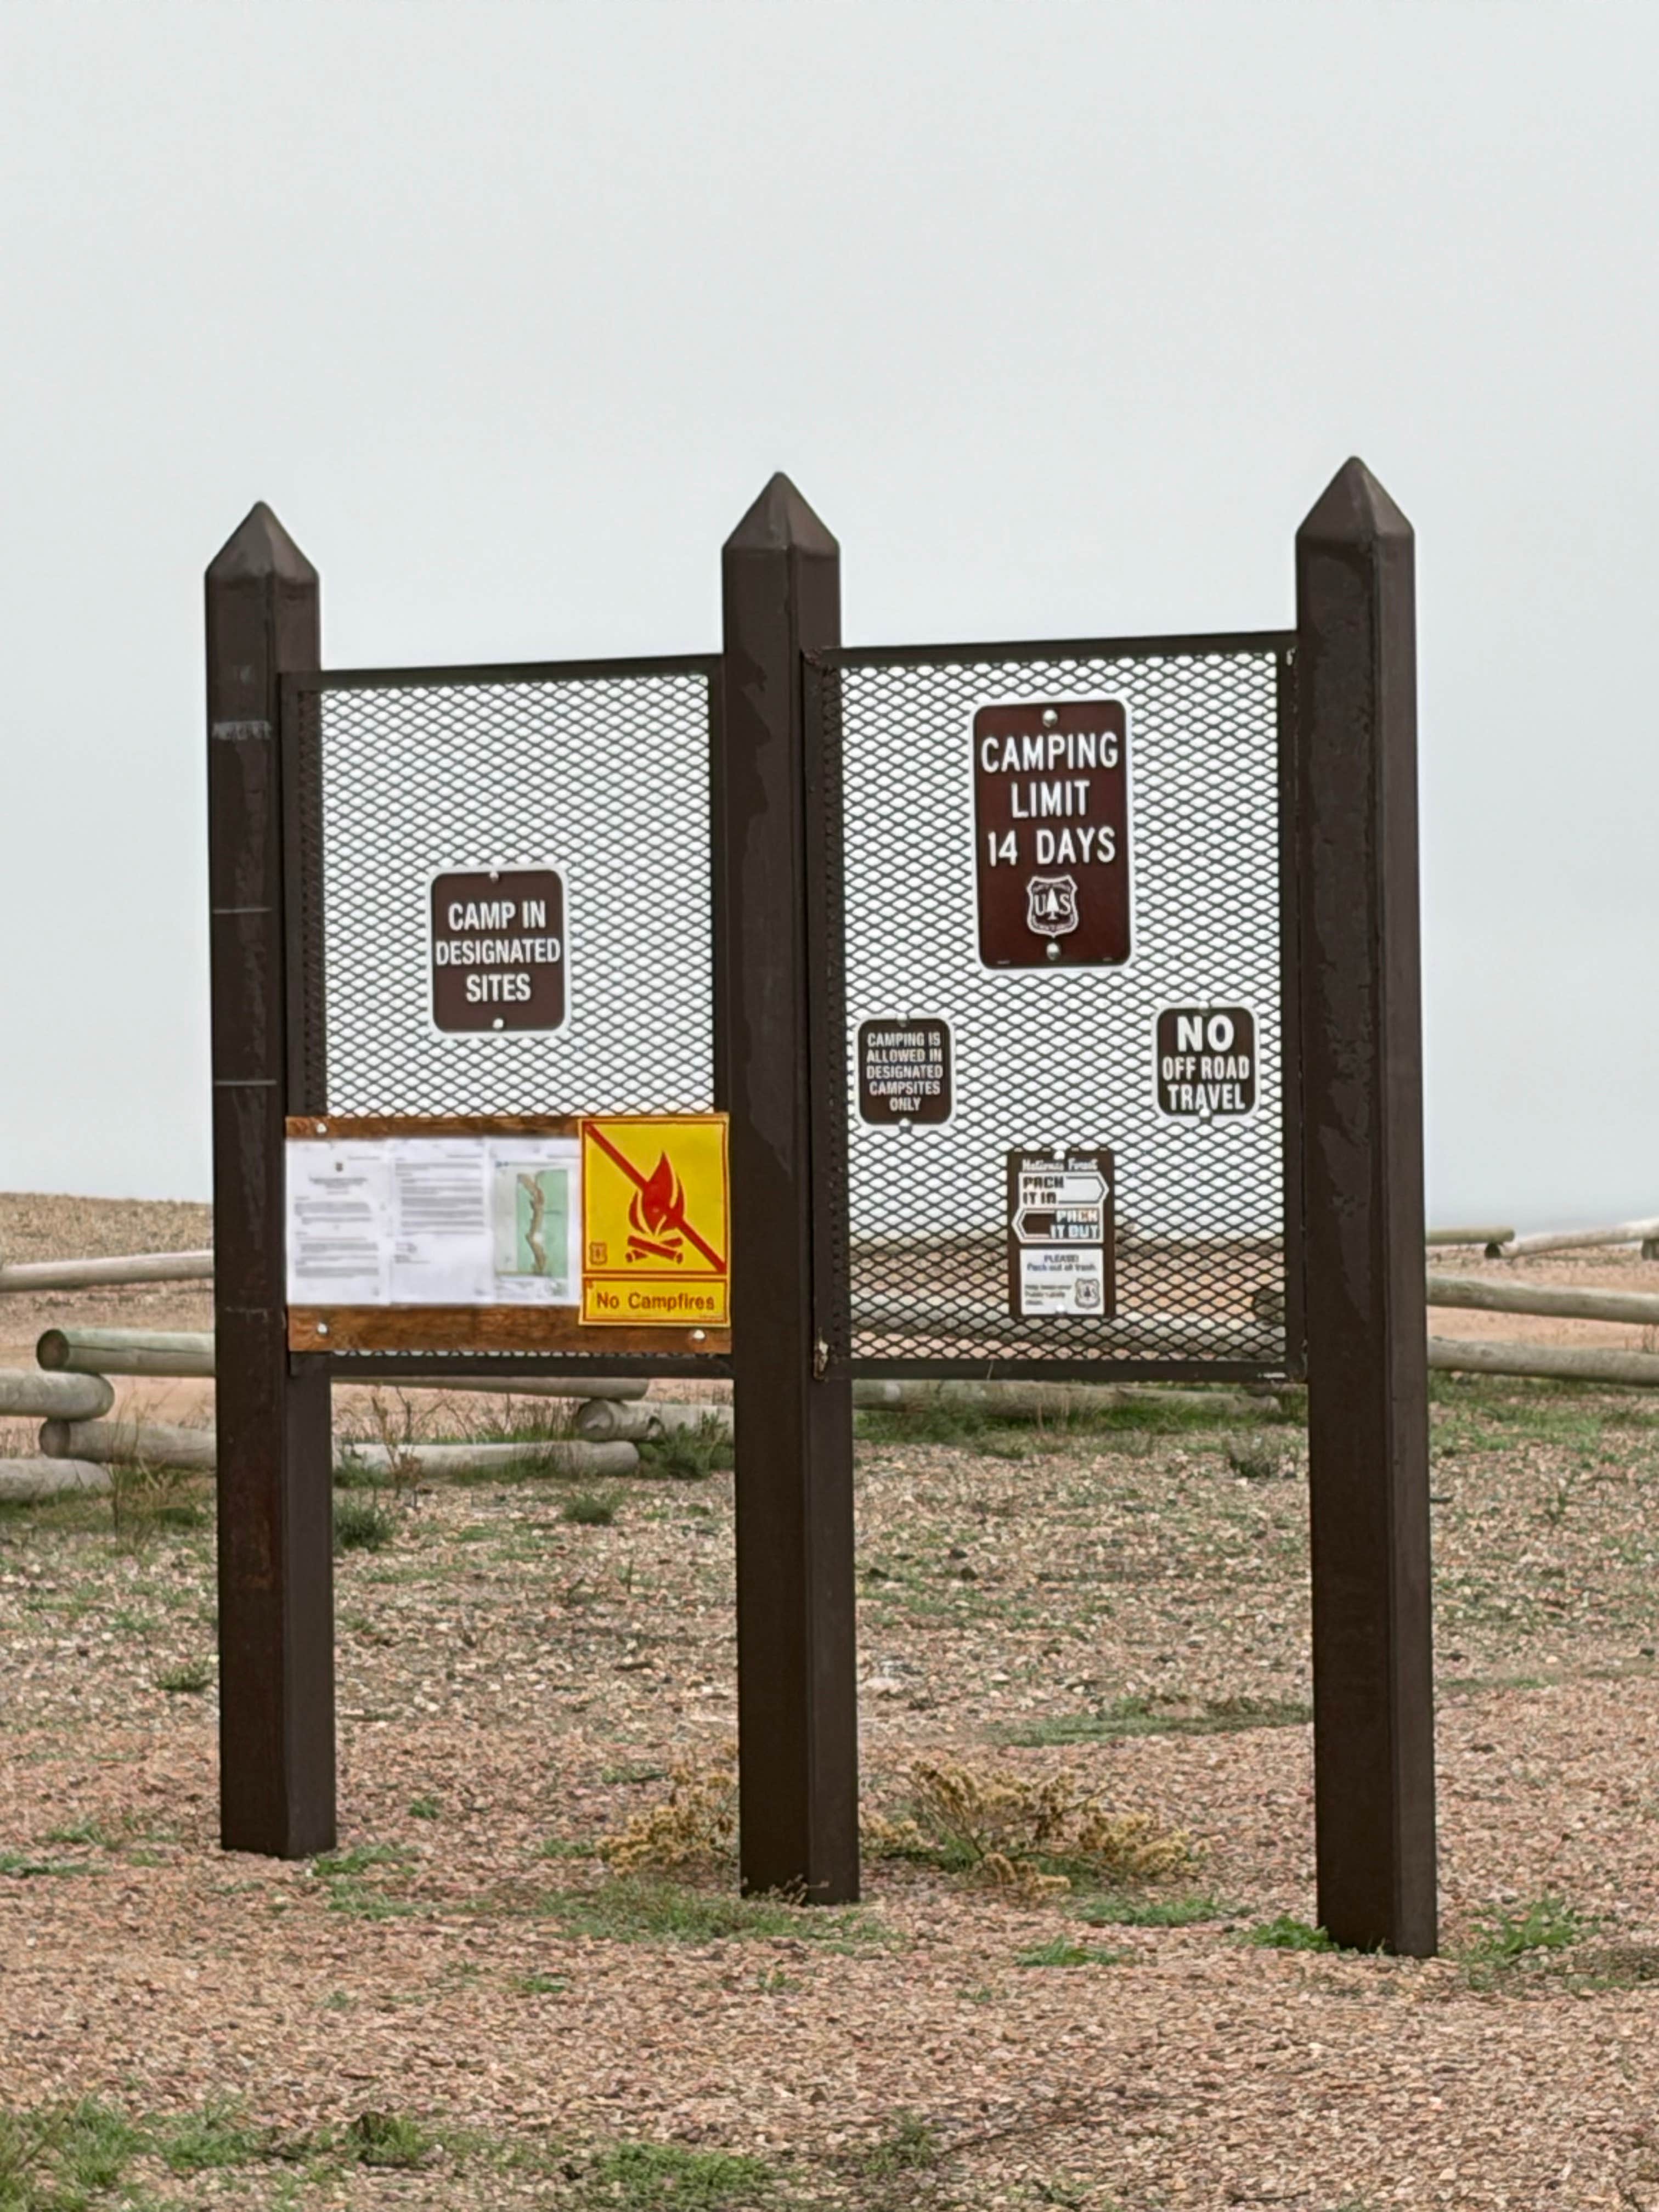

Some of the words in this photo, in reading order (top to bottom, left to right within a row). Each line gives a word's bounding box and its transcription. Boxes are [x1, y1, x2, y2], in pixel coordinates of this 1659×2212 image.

[981, 731, 1119, 773] CAMPING
[1011, 780, 1090, 819] LIMIT
[988, 830, 1017, 867] 14
[1036, 826, 1115, 865] DAYS
[448, 901, 516, 930] CAMP
[522, 900, 546, 928] IN
[436, 938, 561, 966] DESIGNATED
[466, 973, 531, 1002] SITES
[867, 1032, 924, 1047] CAMPING
[928, 1031, 940, 1046] IS
[1177, 1015, 1234, 1052] NO
[866, 1048, 926, 1063] ALLOWED
[929, 1048, 942, 1062] IN
[1163, 1056, 1196, 1080] OFF
[1201, 1055, 1249, 1080] ROAD
[866, 1064, 943, 1079] DESIGNATED
[869, 1081, 940, 1095] CAMPSITES
[1167, 1083, 1245, 1110] TRAVEL
[889, 1097, 921, 1111] ONLY
[1023, 1192, 1036, 1204] IT
[1051, 1224, 1064, 1239] IT
[1068, 1224, 1098, 1239] OUT
[597, 1291, 619, 1309] No
[628, 1292, 714, 1312] Campfires
